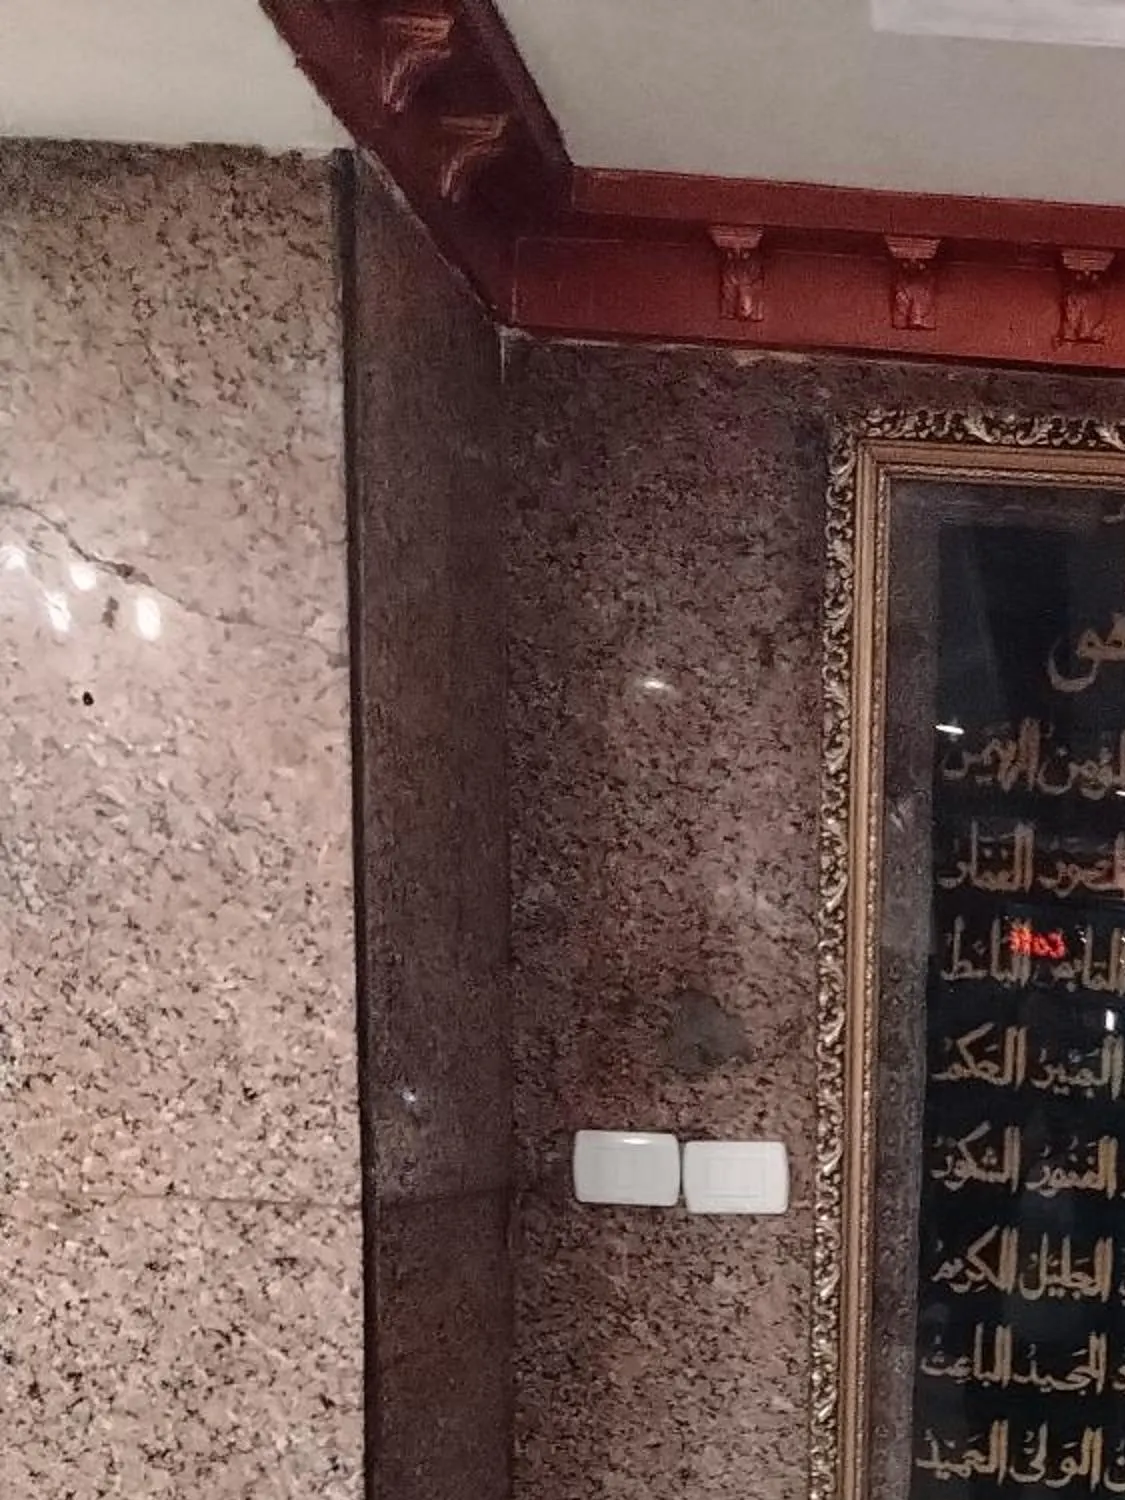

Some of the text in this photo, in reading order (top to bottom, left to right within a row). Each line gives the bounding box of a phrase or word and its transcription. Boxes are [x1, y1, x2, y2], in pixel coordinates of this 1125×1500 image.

[933, 1022, 1027, 1087] الحكم
[1031, 1030, 1124, 1099] البصير
[932, 1121, 1020, 1193] الشكور
[1024, 1132, 1118, 1200] الغفور
[931, 1222, 1019, 1294] الكريم
[1019, 1232, 1113, 1303] الجليل
[920, 1321, 1012, 1388] الباعث
[1012, 1328, 1107, 1395] المجيد
[915, 1415, 1008, 1484] الحميد
